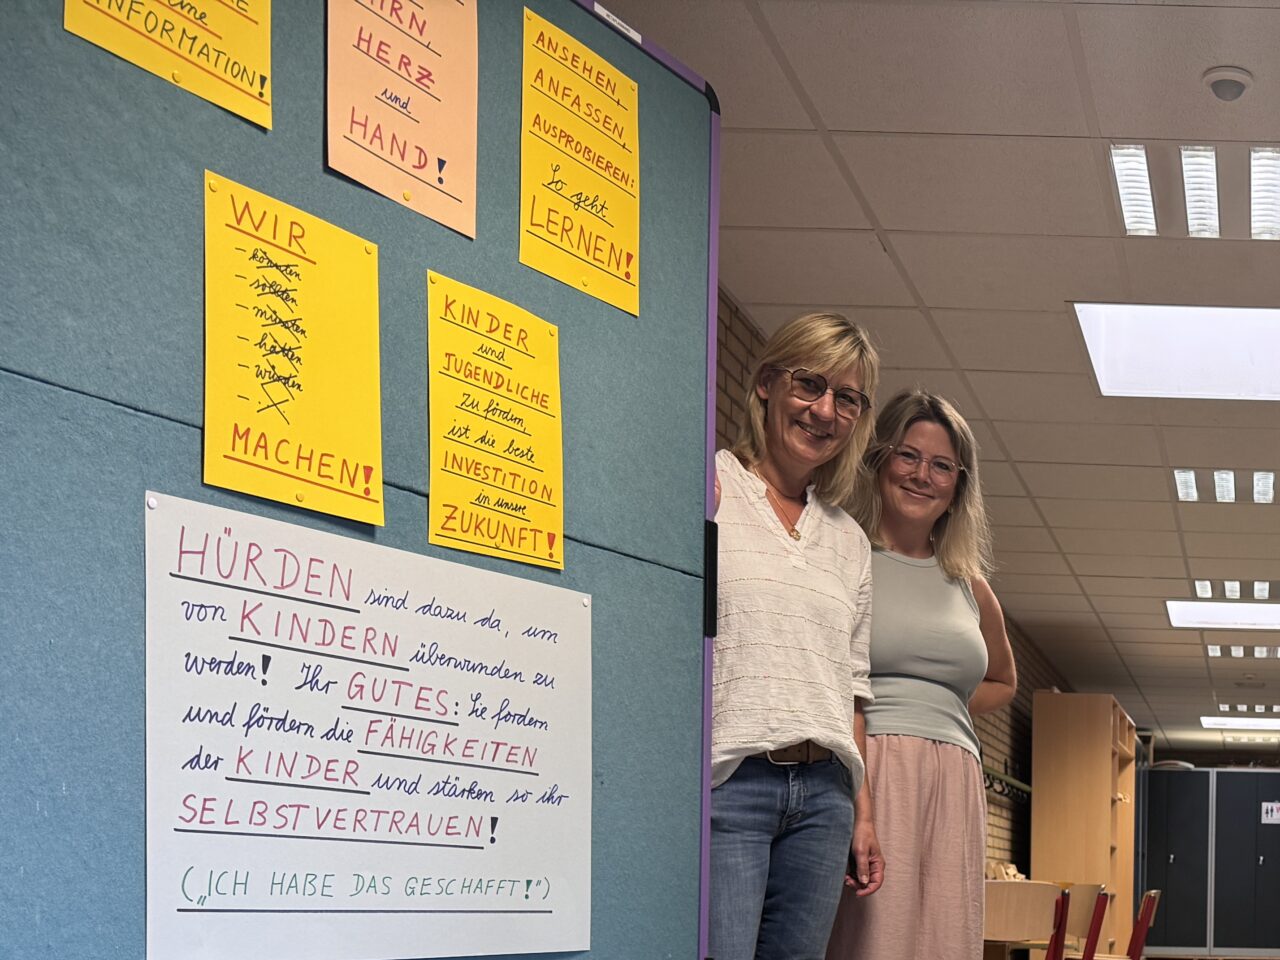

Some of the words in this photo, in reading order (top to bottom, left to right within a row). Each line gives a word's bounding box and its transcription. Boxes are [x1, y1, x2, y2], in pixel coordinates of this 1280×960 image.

[96, 0, 268, 98] NFORMATION!
[356, 26, 435, 90] HERZ
[535, 30, 621, 107] ANSEHEN,
[381, 88, 412, 114] und
[533, 67, 627, 149] ANFASSEN,
[349, 105, 447, 185] HAND!
[532, 113, 635, 189] AUSPROBIEREN:
[231, 194, 306, 255] WIR
[570, 190, 609, 219] geht
[530, 195, 634, 281] LERNEN!
[443, 294, 529, 352] KINDER
[477, 342, 506, 362] und
[443, 353, 549, 409] JUGENDLICHE
[231, 423, 373, 496] MACHEN!
[447, 419, 471, 440] ist
[476, 427, 496, 450] die
[504, 438, 535, 464] beste
[443, 451, 553, 501] INVESTITION
[475, 489, 491, 505] in
[440, 503, 556, 559] ZUKUNFT!
[178, 525, 353, 602] HÜRDEN
[364, 587, 409, 610] sind
[415, 597, 467, 623] dazu
[473, 608, 509, 638] da,
[521, 625, 558, 643] um
[181, 600, 227, 622] von
[240, 600, 399, 658] KINDERN
[409, 642, 525, 683] überwunden
[532, 672, 555, 690] zu
[184, 650, 272, 687] werden!
[295, 662, 339, 694] Ihr
[347, 671, 460, 717] GUTES:
[491, 697, 549, 731] fordern
[182, 702, 236, 728] und
[243, 703, 315, 738] fördern
[320, 717, 354, 743] die
[365, 717, 538, 768] FÄHIGKEITEN
[181, 745, 224, 771] der
[235, 746, 359, 786] KINDER
[371, 773, 421, 795] und
[427, 776, 495, 803] stärken
[506, 788, 533, 804] so
[536, 783, 569, 807] ihr
[178, 794, 499, 845] SELBSTVERTRAUEN!
[270, 871, 336, 898] HABE
[349, 873, 393, 897] DAS
